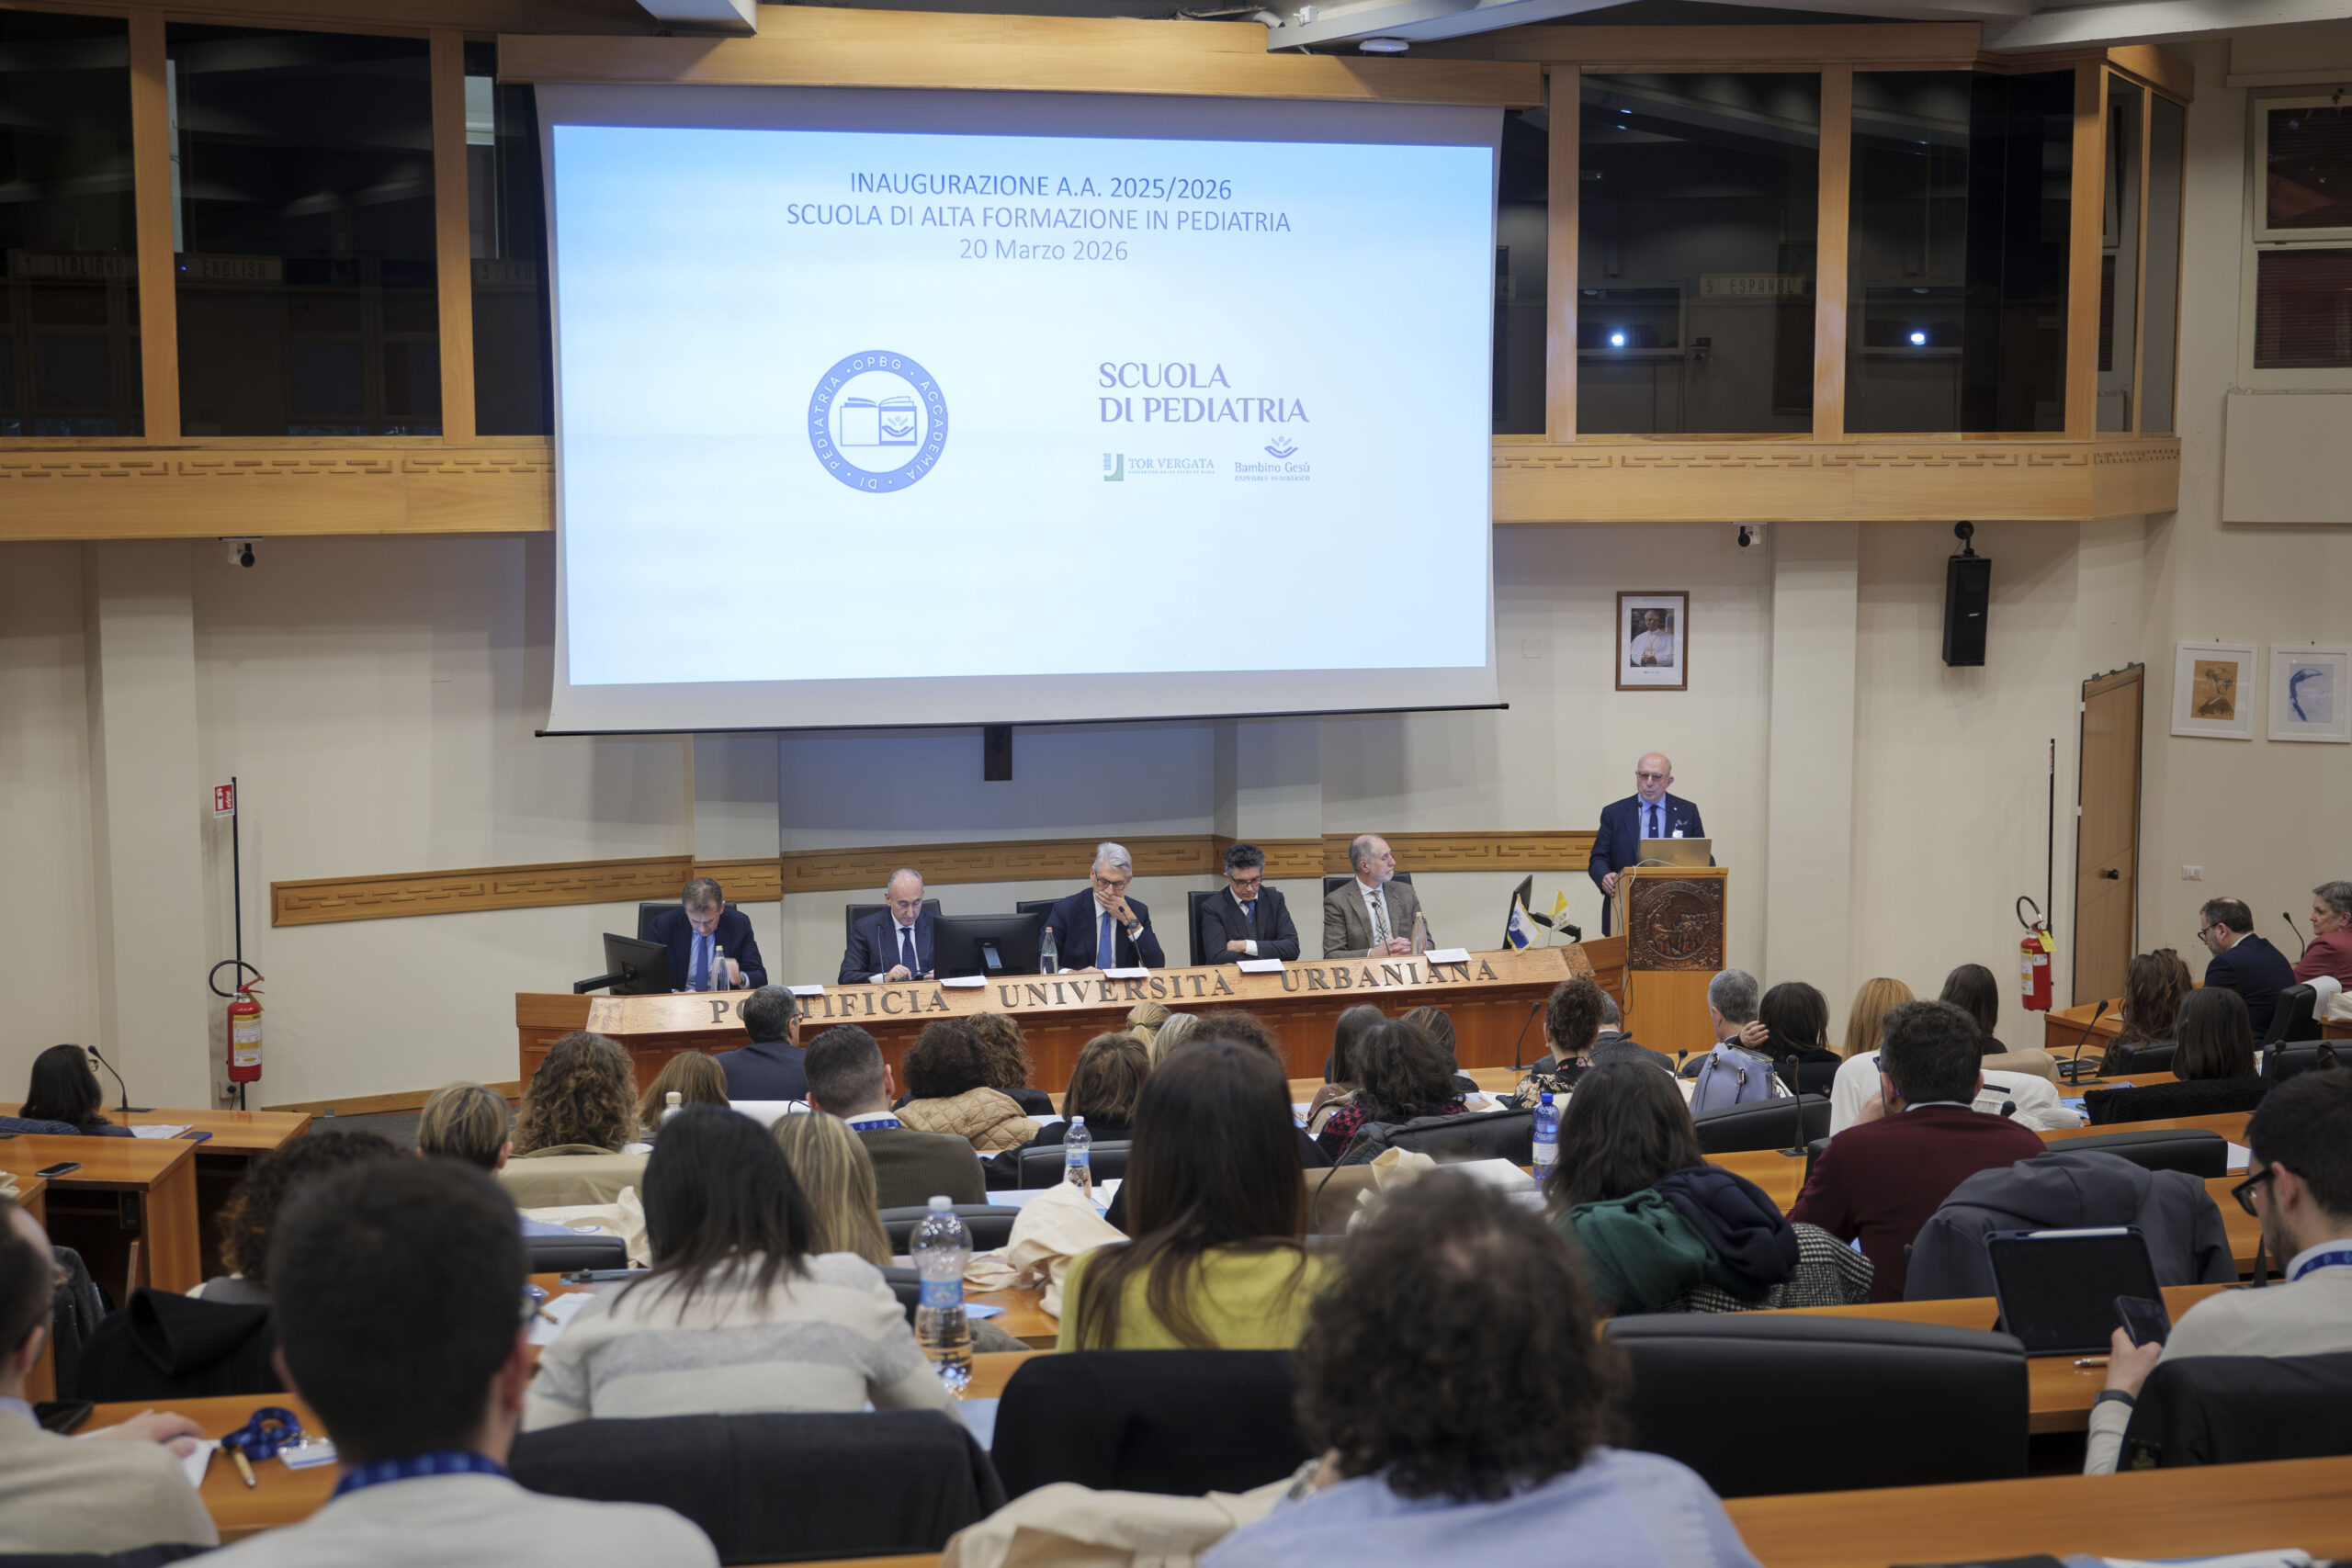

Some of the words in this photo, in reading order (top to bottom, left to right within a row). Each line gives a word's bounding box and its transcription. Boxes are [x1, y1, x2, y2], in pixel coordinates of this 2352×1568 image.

[851, 172, 1049, 197] INAUGURAZIONE
[1057, 176, 1102, 197] A.A.
[1110, 177, 1232, 201] 2025/2026
[786, 203, 882, 227] SCUOLA
[890, 205, 913, 227] DI
[921, 206, 976, 228] ALTA
[983, 207, 1138, 230] FORMAZIONE
[1147, 210, 1169, 231] IN
[1177, 210, 1291, 232] PEDIATRIA
[960, 239, 988, 259] 20
[996, 239, 1066, 261] Marzo
[1073, 241, 1129, 262] 2026
[202, 260, 266, 279] ENGLISH
[853, 356, 902, 370] OPBG
[1100, 362, 1231, 389] SCUOLA
[814, 376, 842, 470] PEDIATRIA
[1099, 397, 1134, 423] DI
[1142, 397, 1310, 423] PEDIATRIA
[906, 381, 944, 479] ACCADEMIA
[1128, 457, 1154, 469] TOR
[1158, 458, 1215, 470] VERGATA
[1234, 461, 1281, 473] Bambino
[1284, 461, 1310, 473] Gesù
[860, 477, 878, 490] DI
[708, 988, 950, 1023] PTIFICIA
[999, 969, 1234, 1009] UNIVERSITÀ
[1280, 958, 1499, 992] URBANIANA
